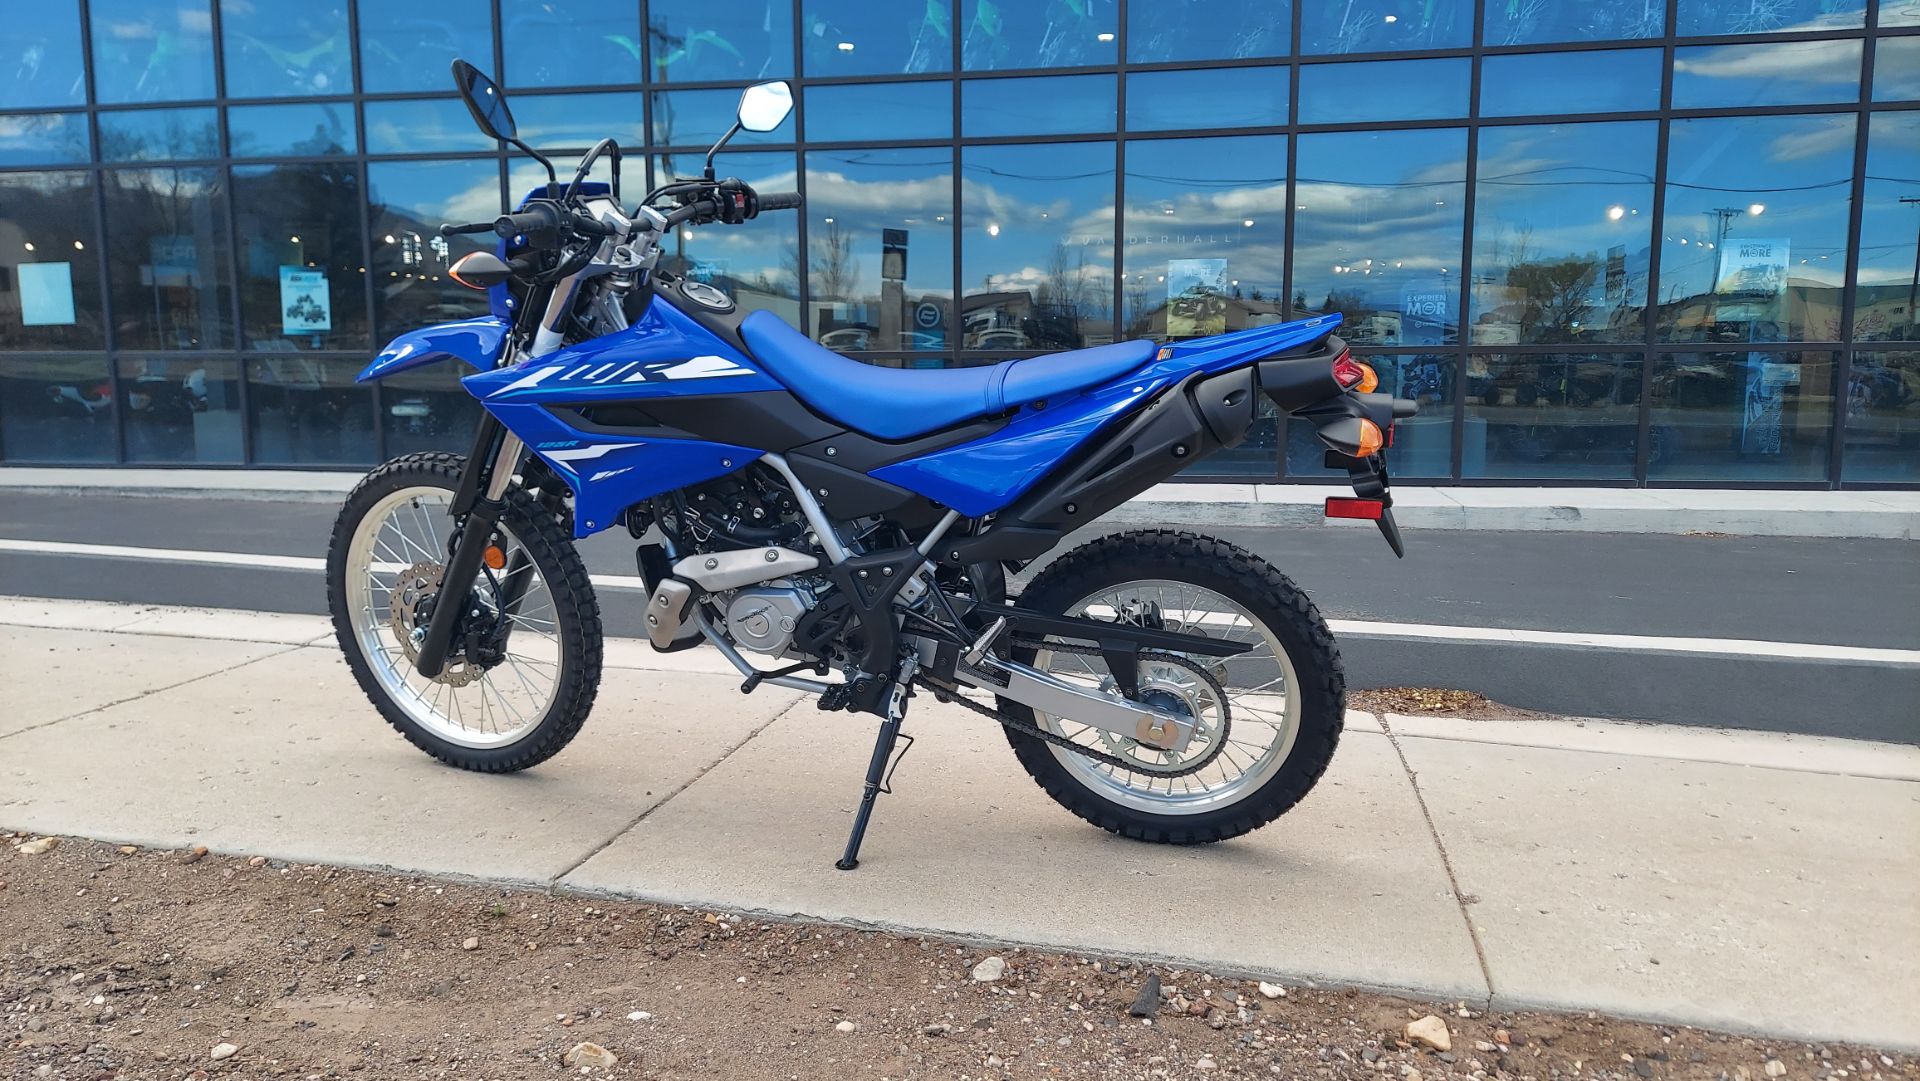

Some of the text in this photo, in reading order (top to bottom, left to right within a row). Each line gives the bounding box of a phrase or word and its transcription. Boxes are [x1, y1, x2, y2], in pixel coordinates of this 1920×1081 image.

[1739, 248, 1771, 258] MORE
[1407, 294, 1447, 302] EXPERIEN
[1406, 301, 1446, 316] MOR
